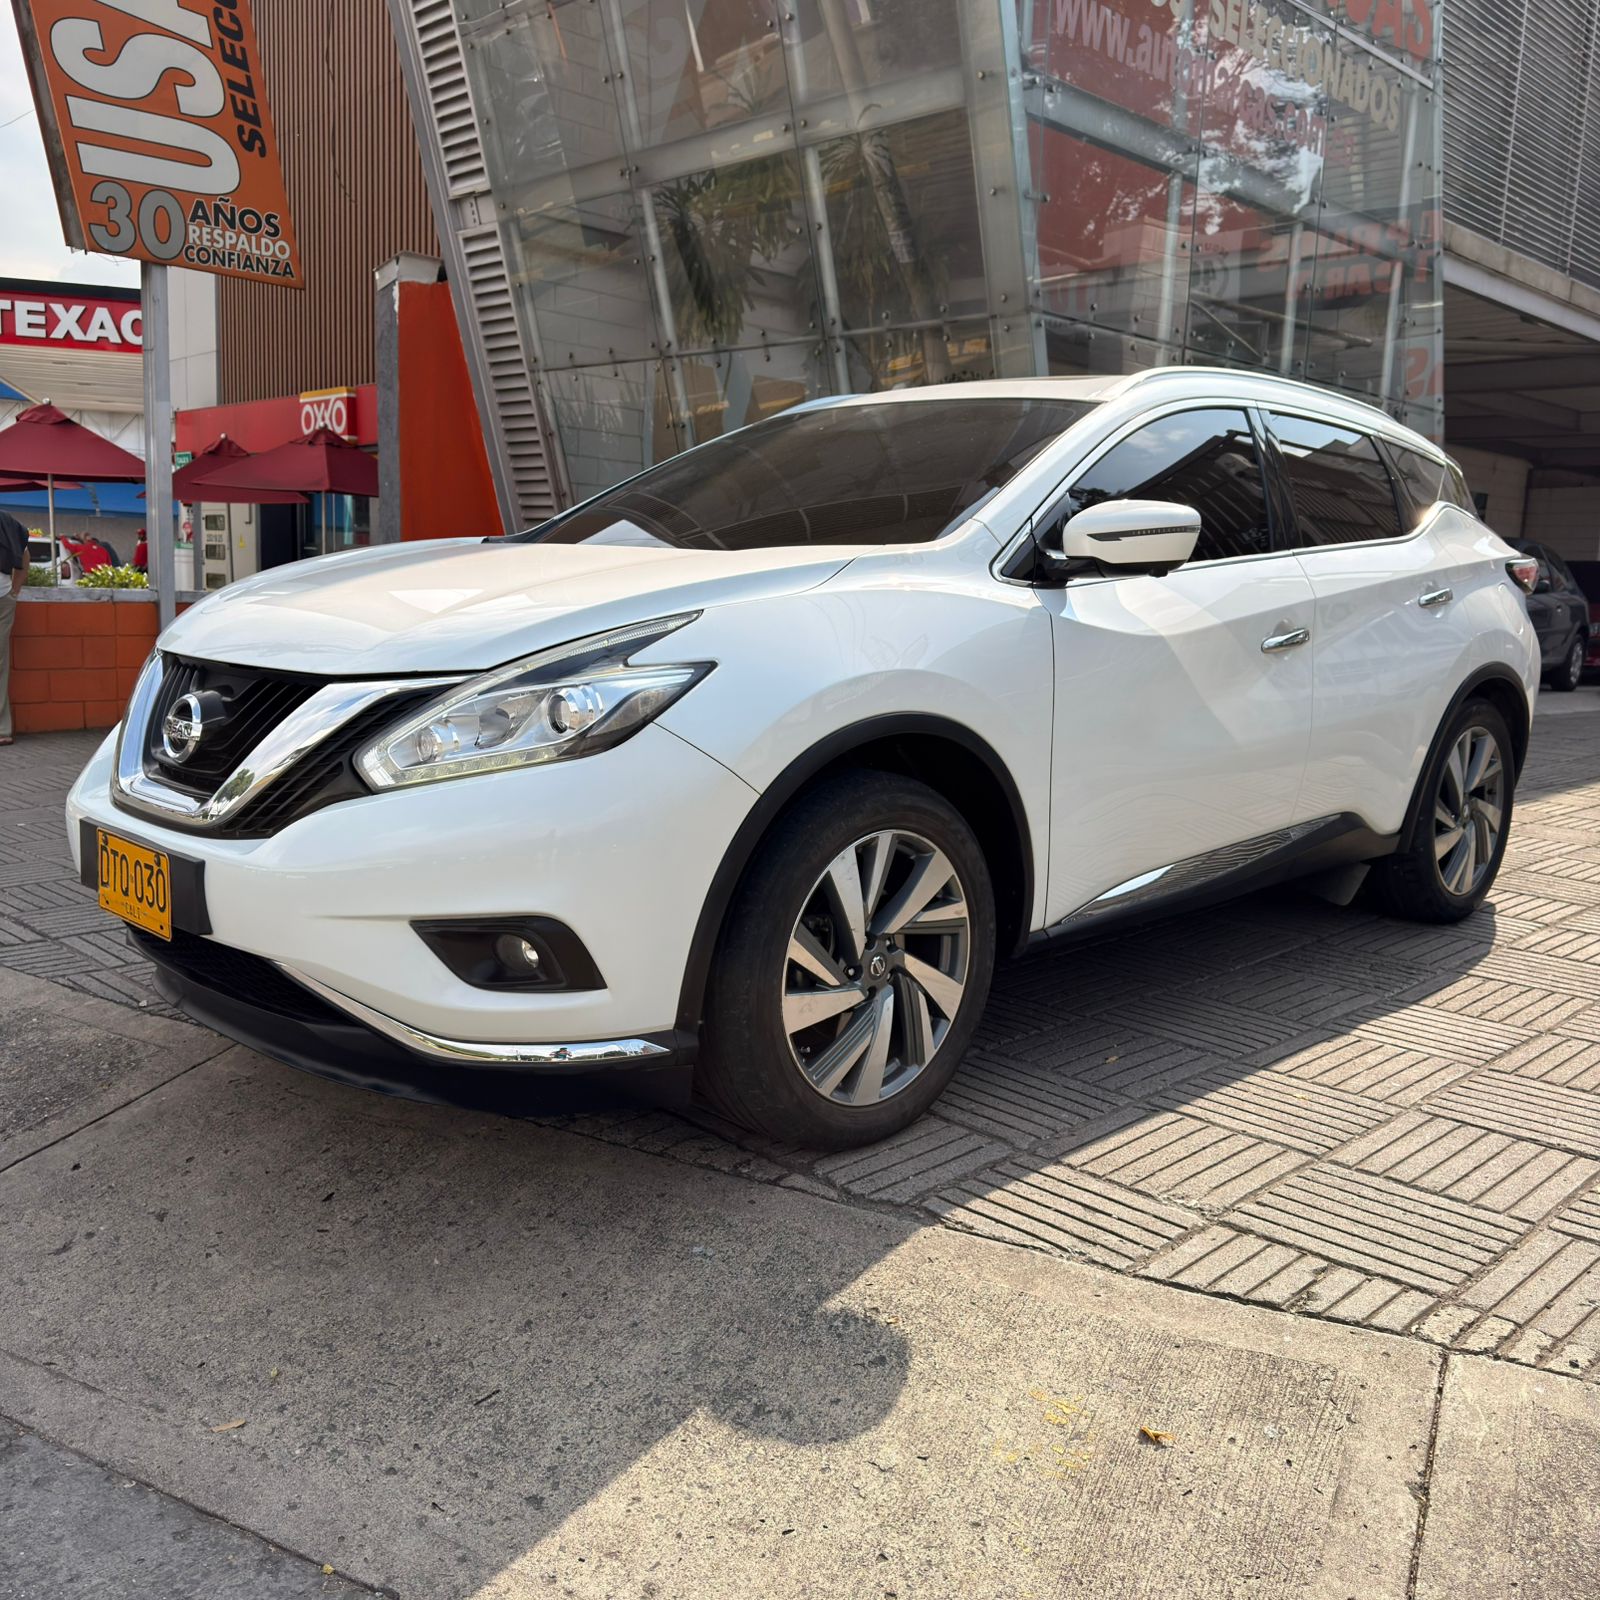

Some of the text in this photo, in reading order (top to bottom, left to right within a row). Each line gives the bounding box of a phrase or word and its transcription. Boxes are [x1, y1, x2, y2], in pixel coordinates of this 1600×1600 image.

[213, 0, 267, 158] SELEC
[88, 180, 187, 260] 30
[187, 196, 281, 240] AÑOS
[184, 244, 296, 279] CONFIANZA
[188, 225, 291, 260] RESPALDO
[301, 396, 347, 436] OXXO
